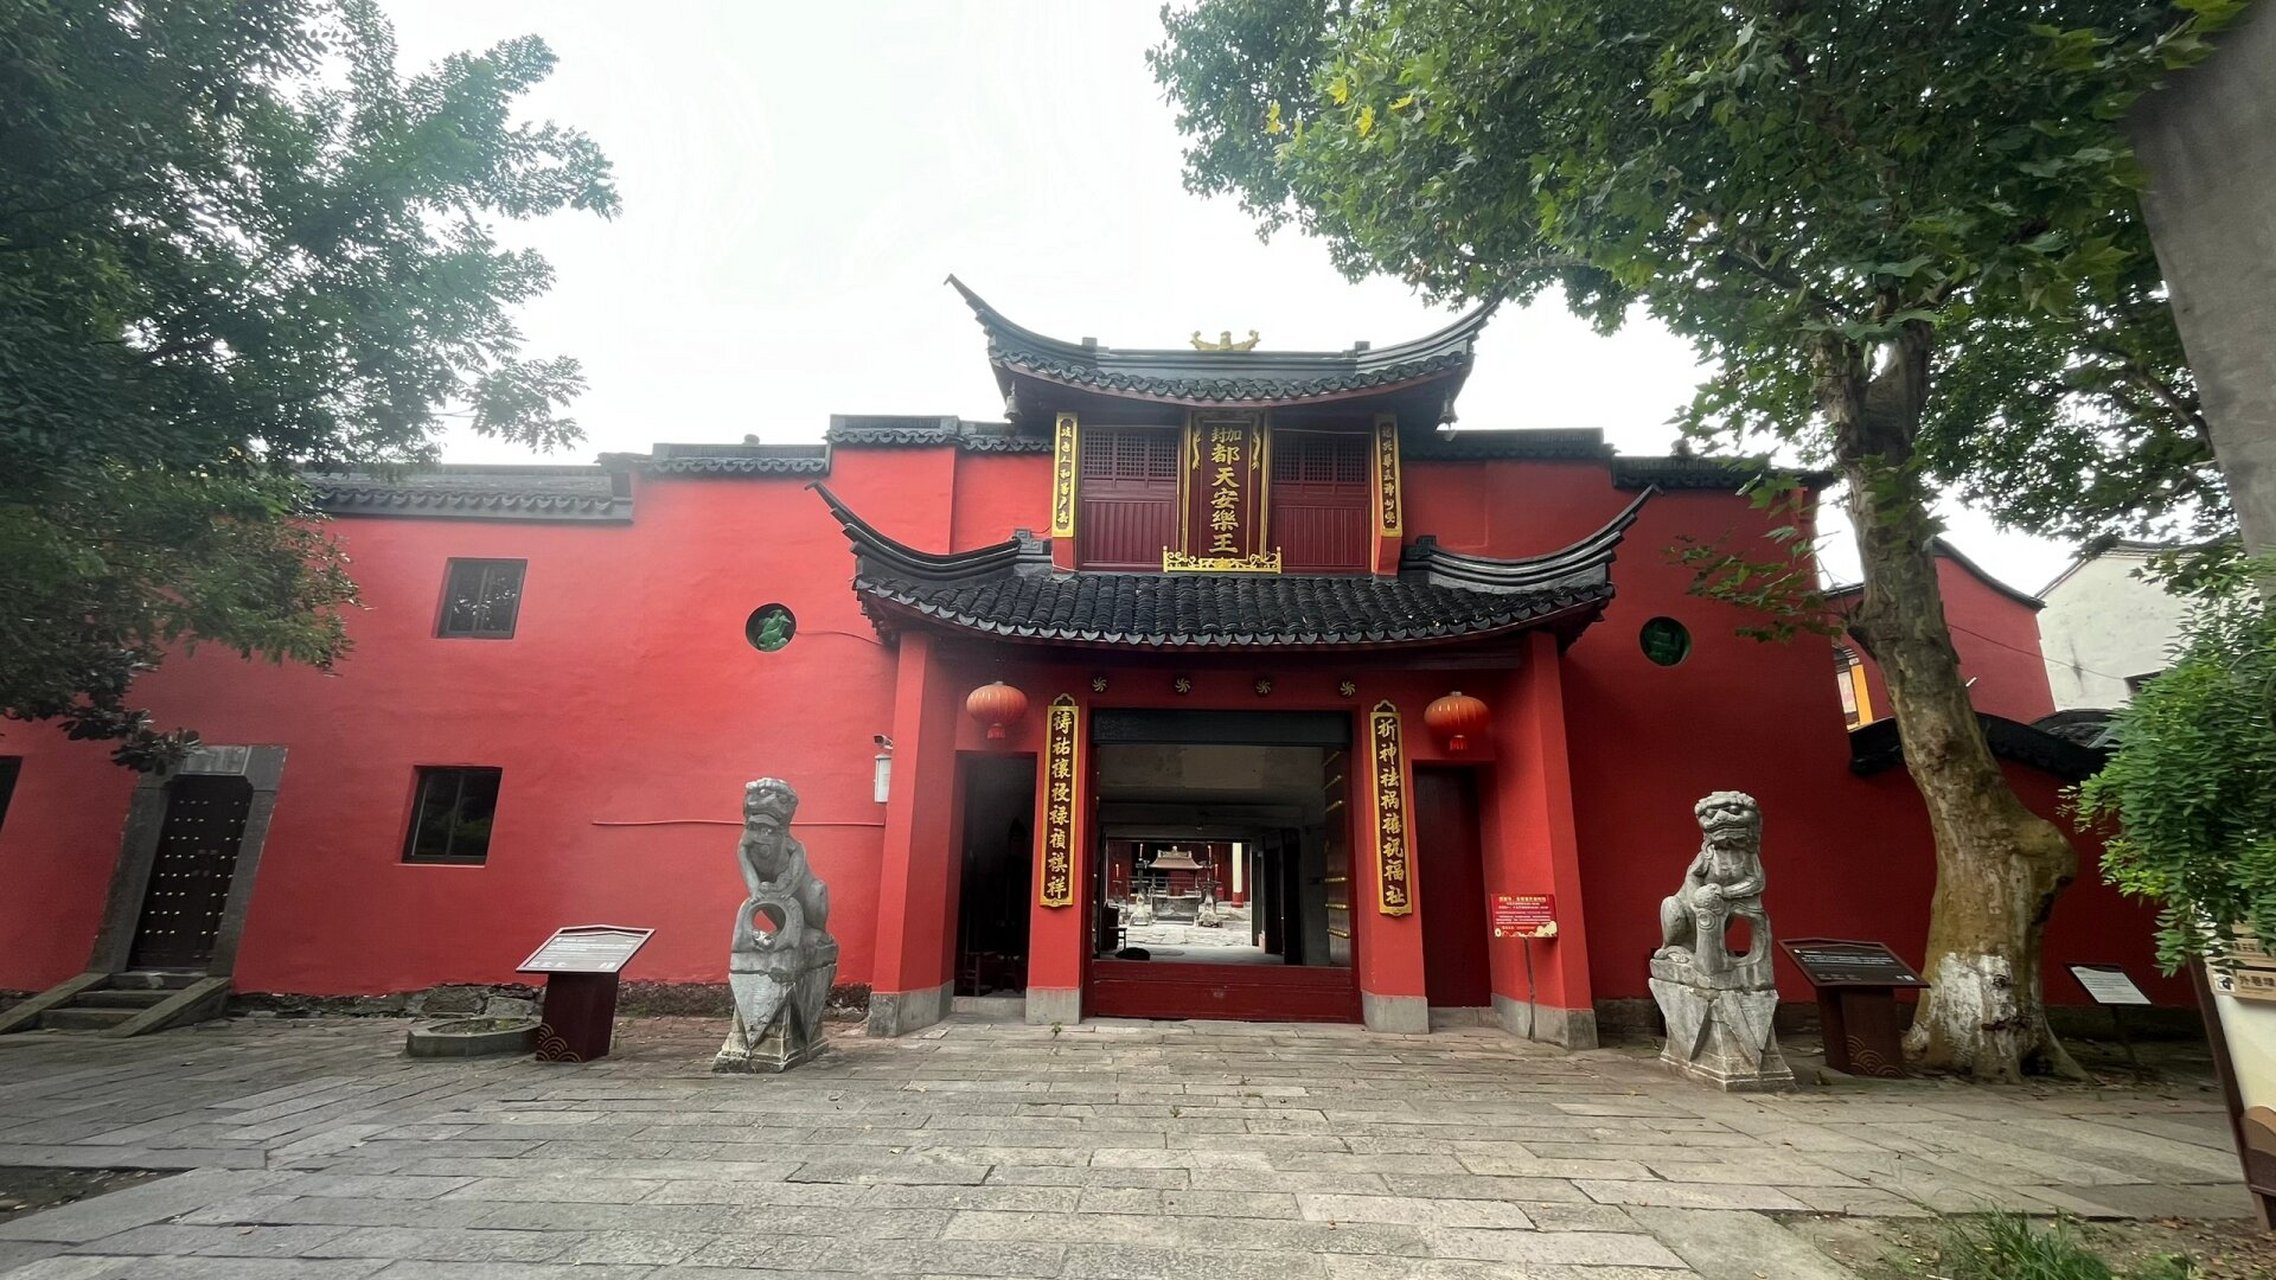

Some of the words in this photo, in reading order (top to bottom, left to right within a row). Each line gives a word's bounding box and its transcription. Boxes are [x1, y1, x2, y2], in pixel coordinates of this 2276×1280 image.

[1208, 443, 1241, 554] 都天安樂王
